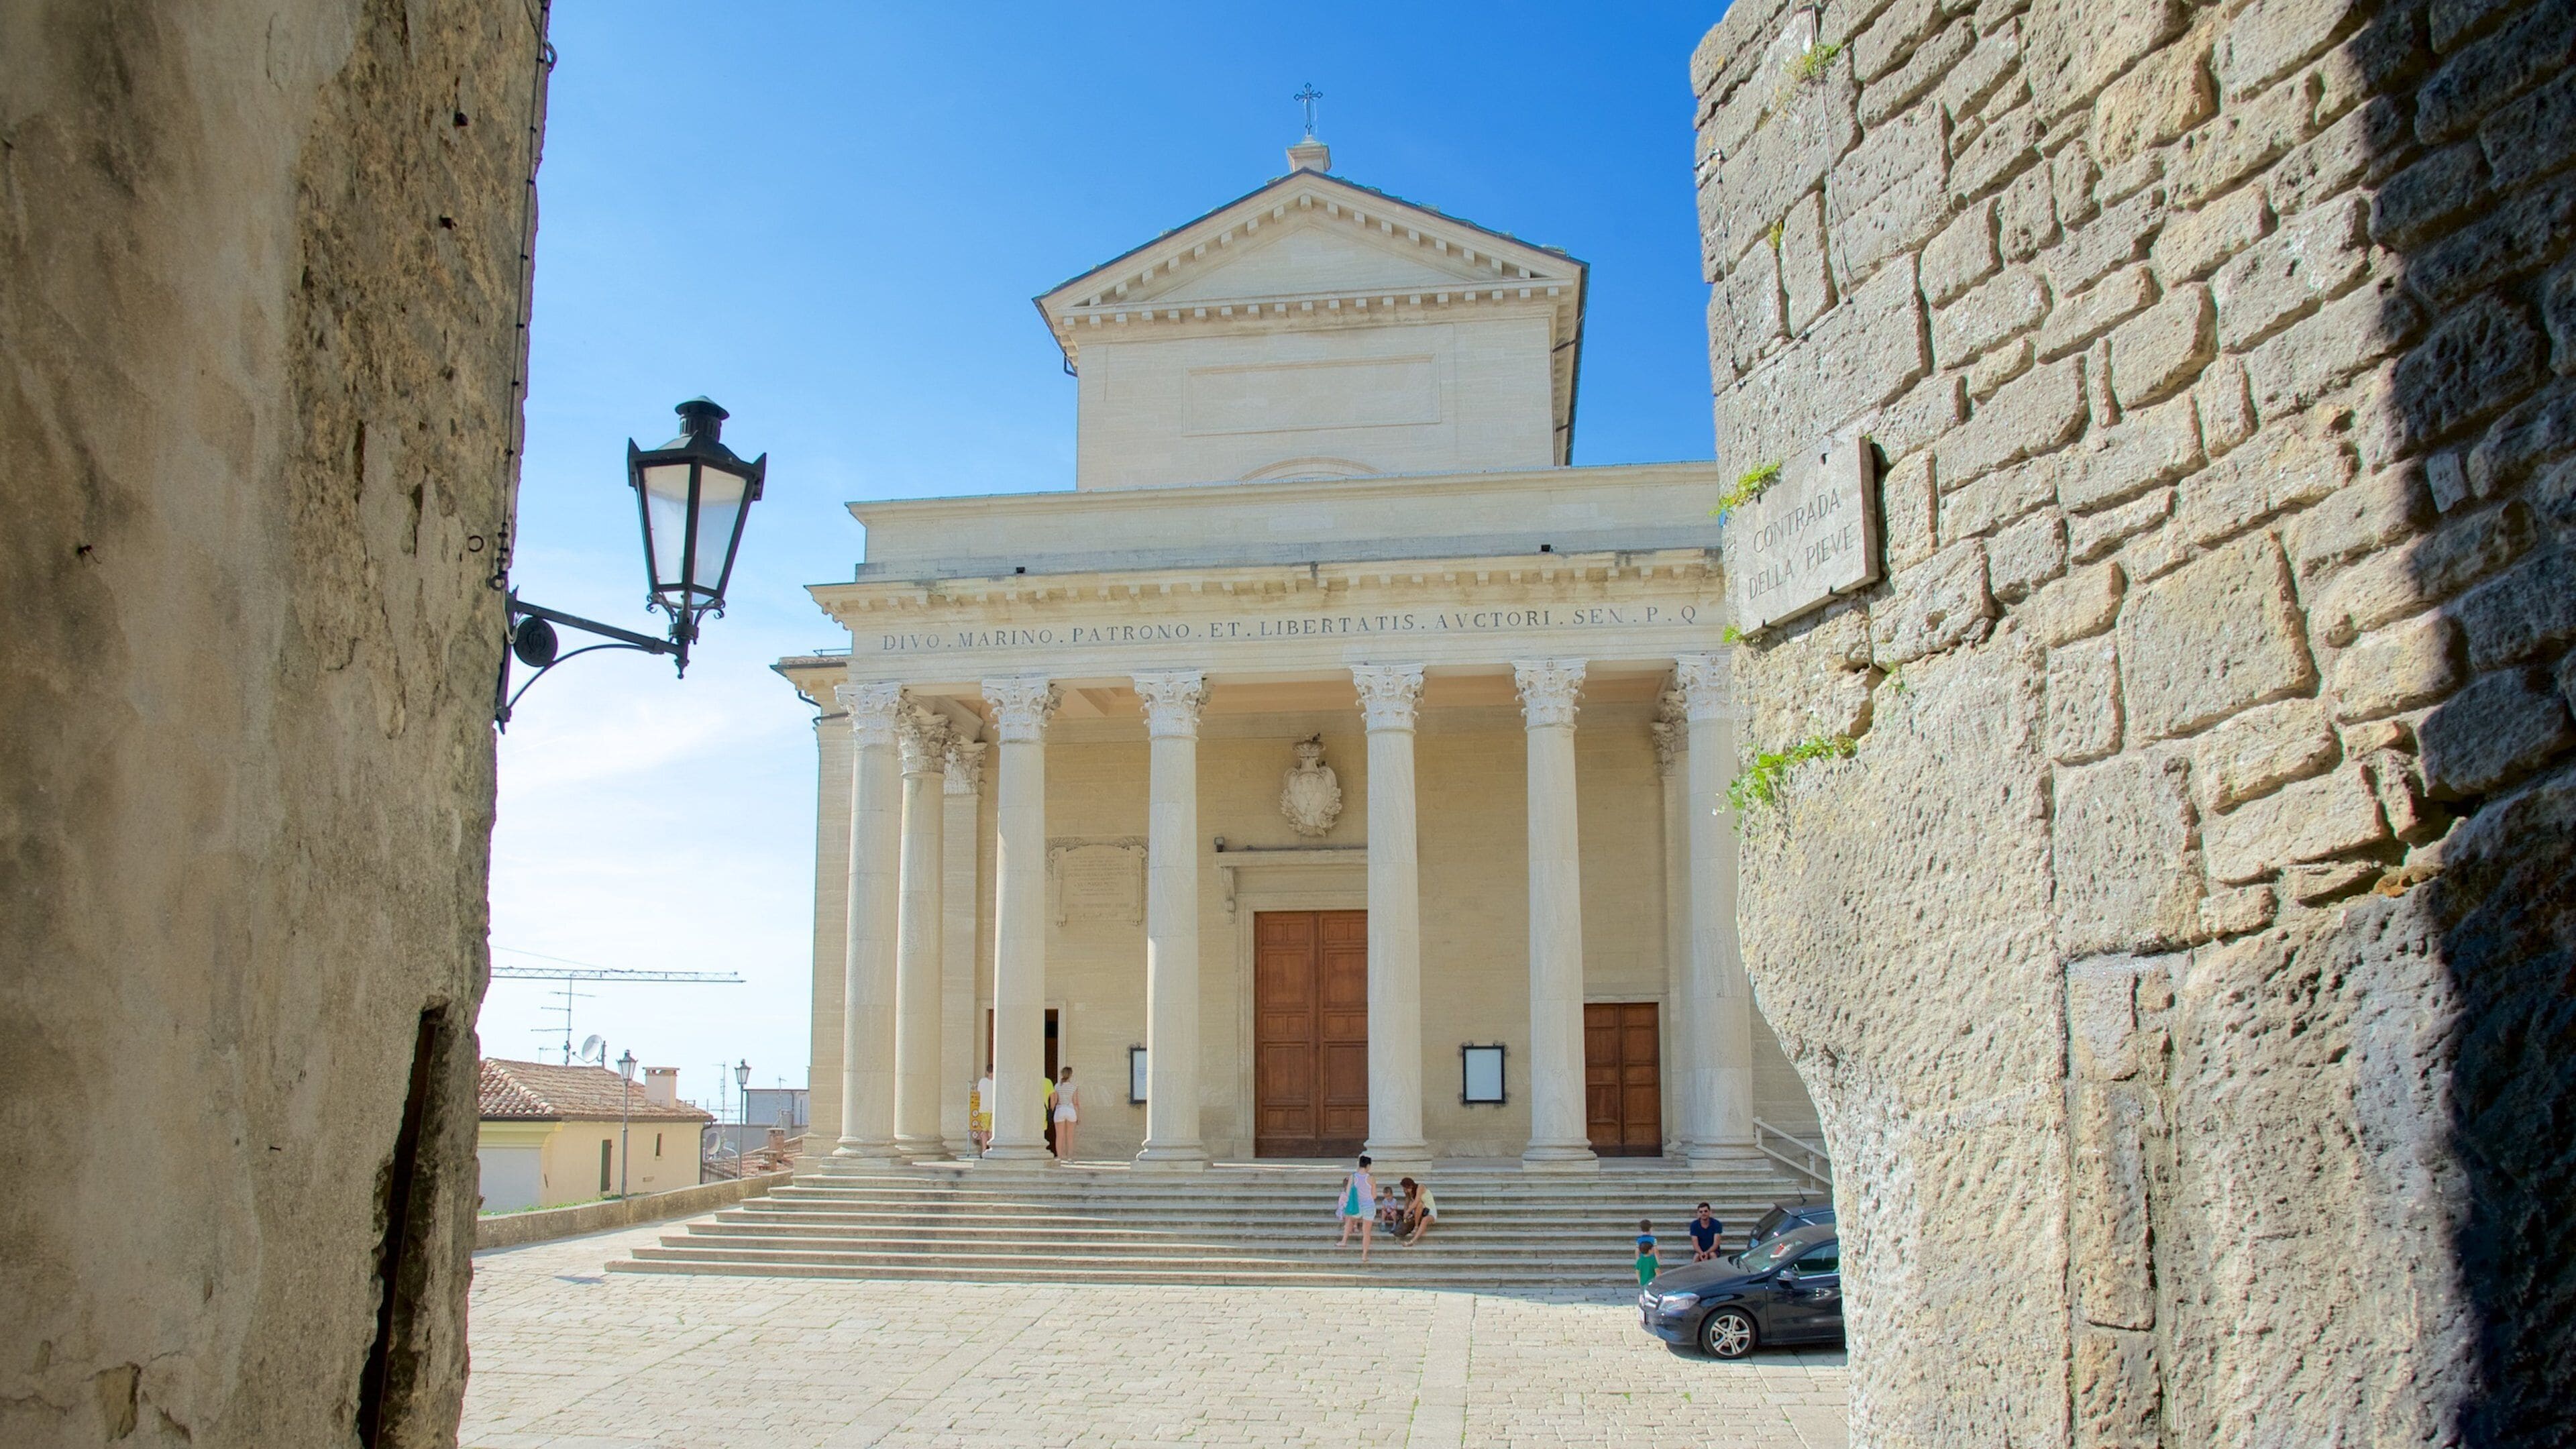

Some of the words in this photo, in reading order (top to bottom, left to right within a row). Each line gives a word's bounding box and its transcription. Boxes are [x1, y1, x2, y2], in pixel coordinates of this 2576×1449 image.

[1754, 488, 1841, 553] CONTRADA
[1749, 559, 1794, 600] DELLA
[1806, 525, 1853, 570] PIEVE
[1681, 605, 1696, 624] Q
